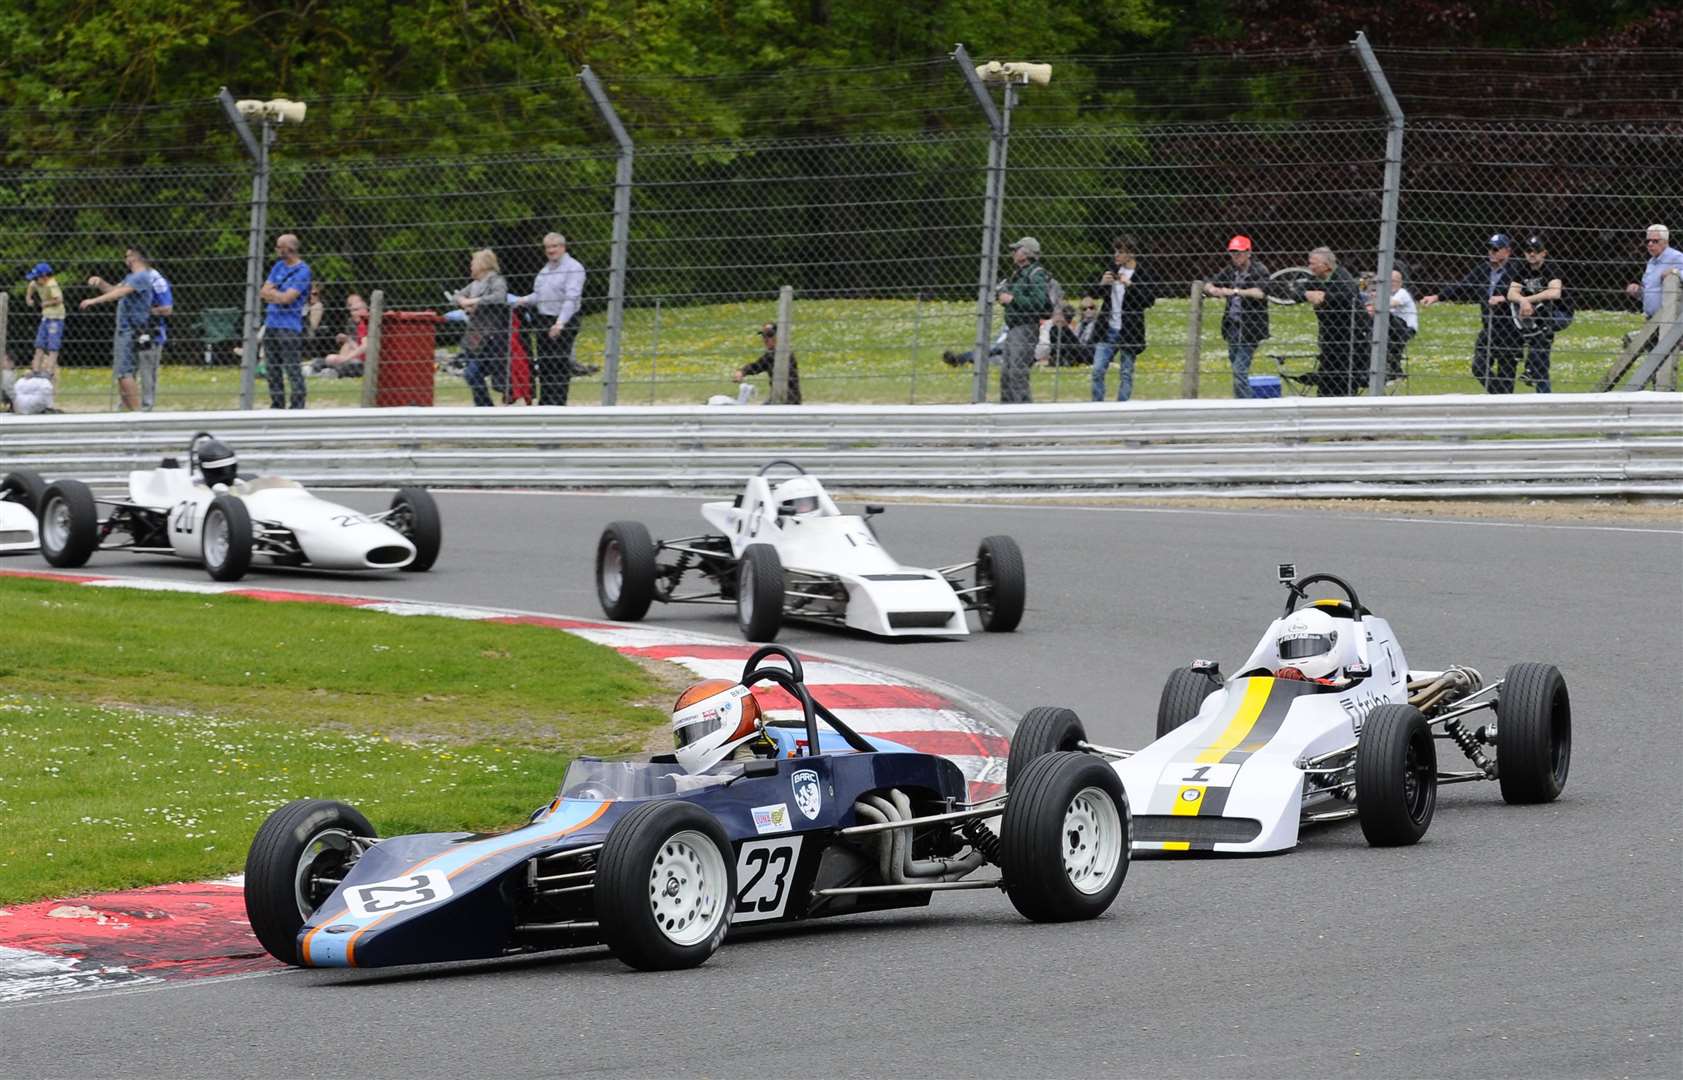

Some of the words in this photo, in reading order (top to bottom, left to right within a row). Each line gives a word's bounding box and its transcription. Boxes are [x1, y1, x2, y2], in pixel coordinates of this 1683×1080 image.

[175, 500, 199, 535] 20
[1386, 647, 1396, 678] 1
[794, 772, 816, 784] BARC
[1182, 766, 1211, 782] 1
[359, 875, 436, 913] 23
[735, 846, 793, 914] 23
